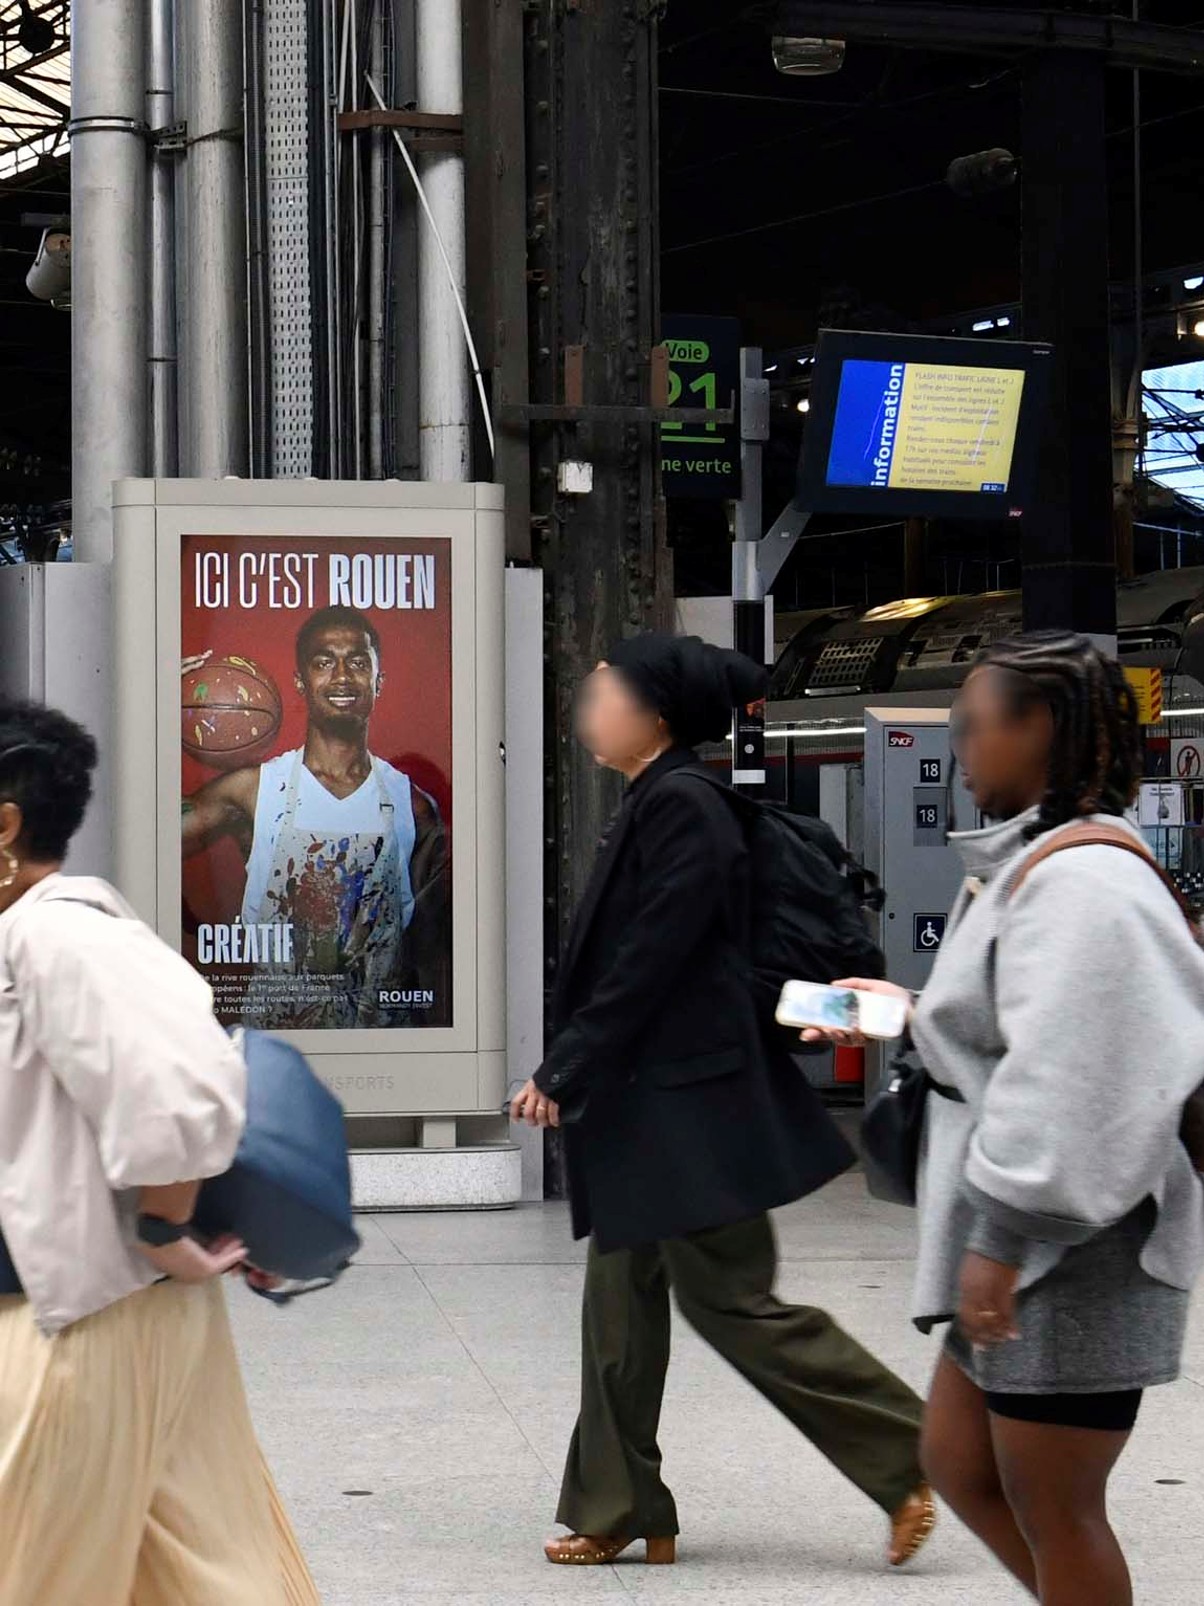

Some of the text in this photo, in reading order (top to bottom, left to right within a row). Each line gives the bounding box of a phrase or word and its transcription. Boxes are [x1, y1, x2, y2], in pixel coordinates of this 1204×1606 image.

[666, 343, 703, 359] Voie
[871, 365, 903, 486] information
[661, 459, 731, 474] ne verte
[195, 552, 435, 609] ICI C'EST ROUEN
[889, 737, 914, 746] SNCF
[922, 763, 939, 777] 18
[919, 809, 936, 823] 18
[221, 974, 238, 982] rive
[306, 974, 345, 984] parquets
[224, 995, 251, 1003] toutes
[379, 990, 434, 1003] ROUEN
